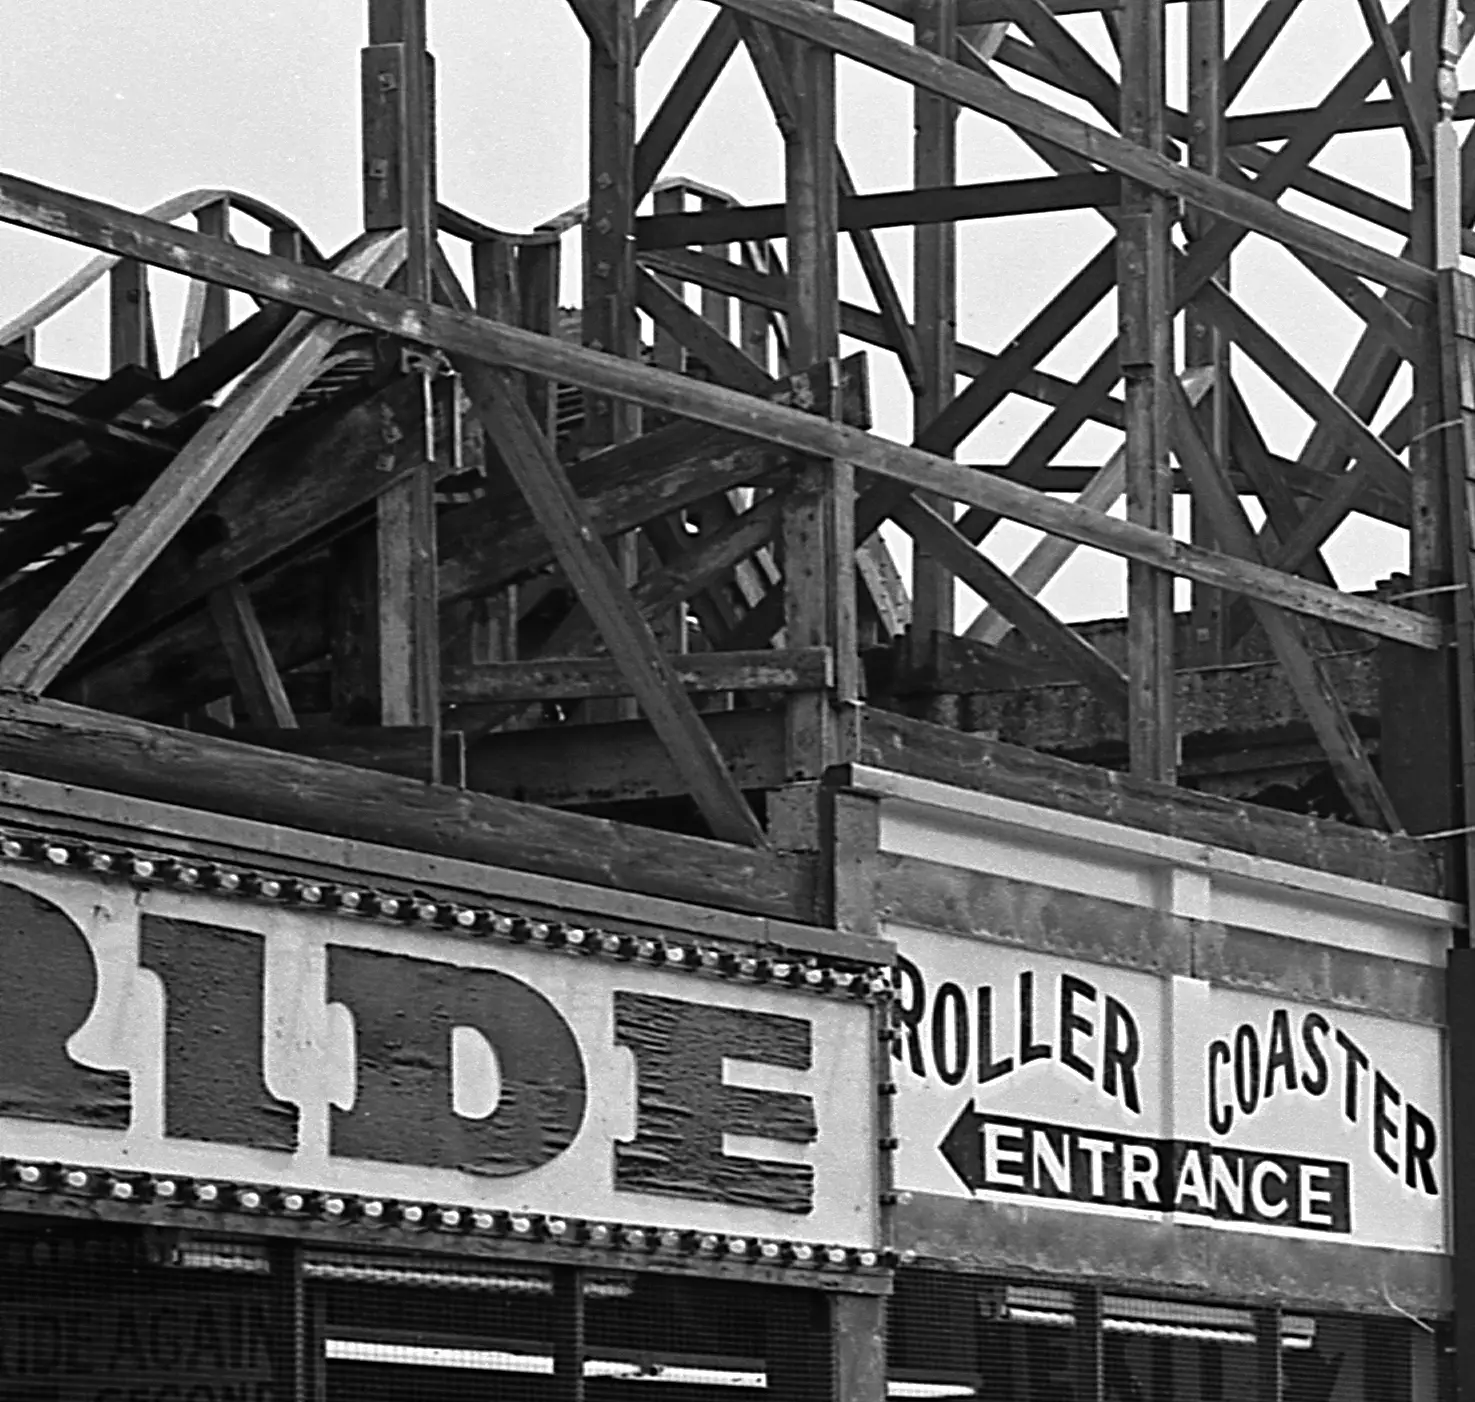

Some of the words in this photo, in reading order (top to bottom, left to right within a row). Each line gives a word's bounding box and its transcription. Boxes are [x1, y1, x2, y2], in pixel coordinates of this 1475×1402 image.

[893, 953, 1141, 1114] ROLLER
[1208, 1008, 1439, 1196] COASTER
[983, 1123, 1333, 1226] ENTRANCE
